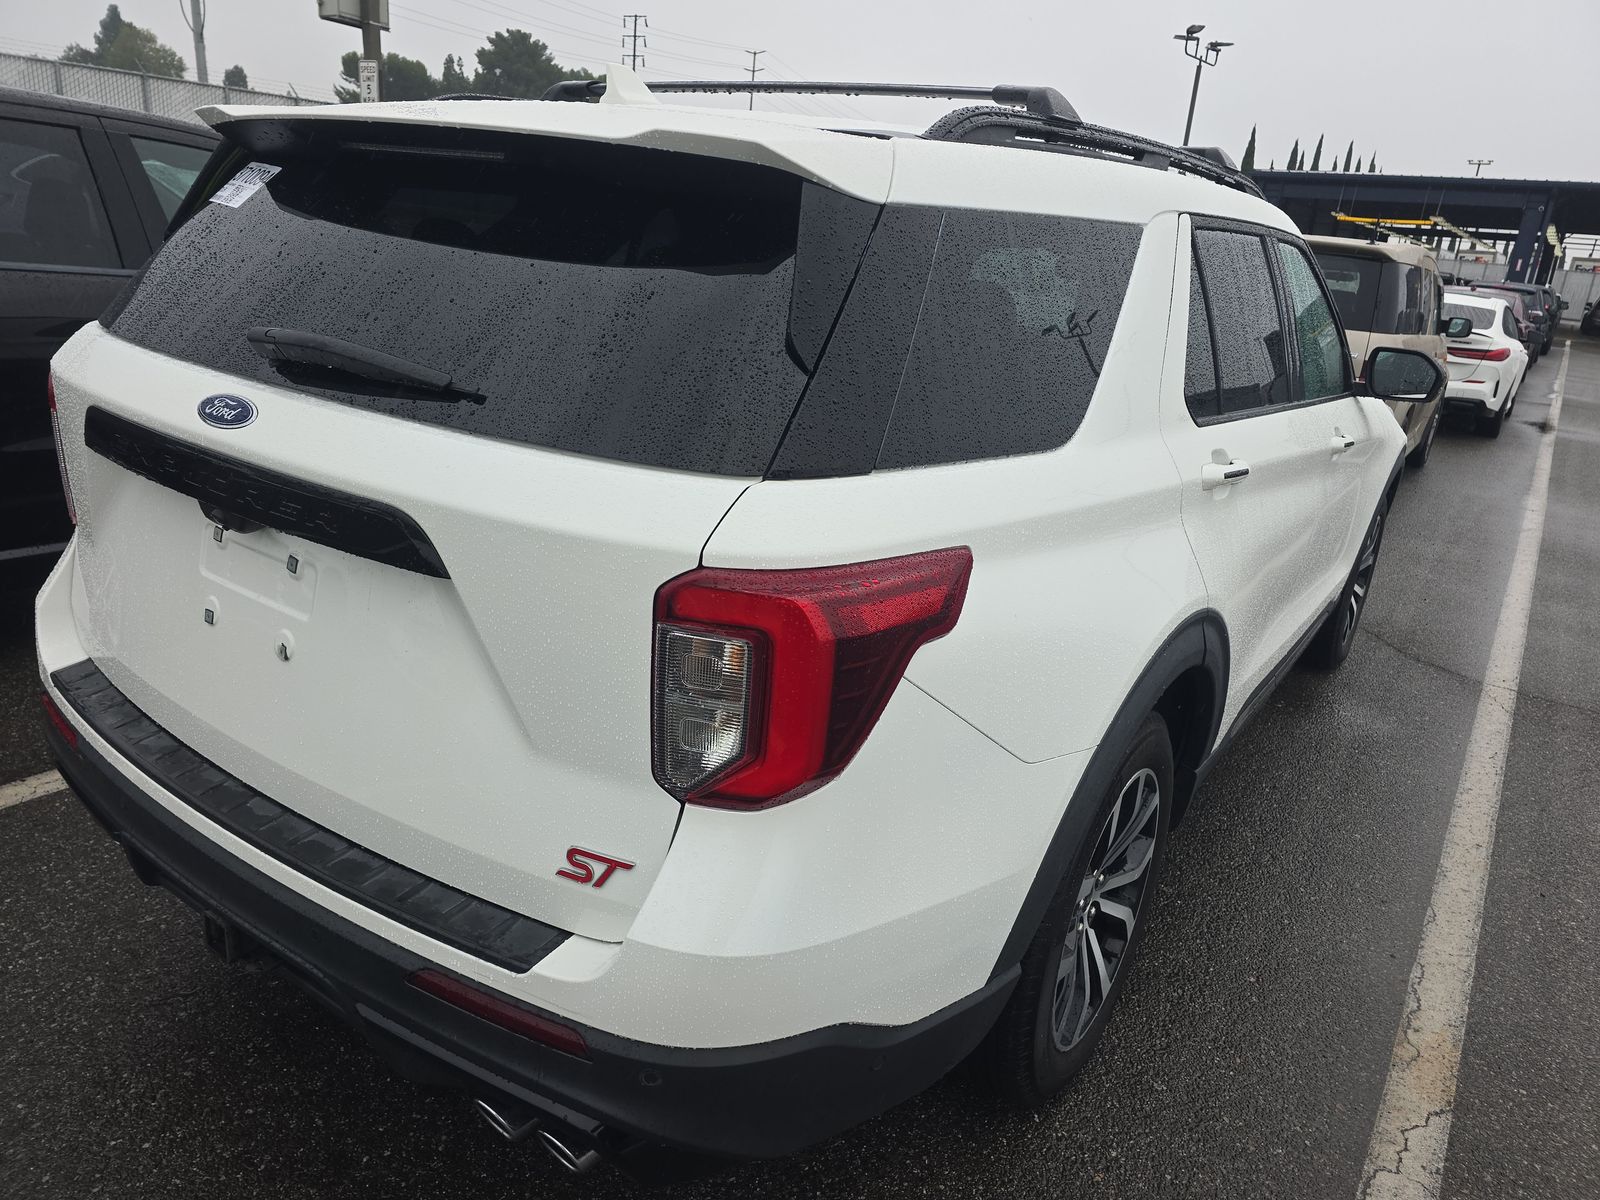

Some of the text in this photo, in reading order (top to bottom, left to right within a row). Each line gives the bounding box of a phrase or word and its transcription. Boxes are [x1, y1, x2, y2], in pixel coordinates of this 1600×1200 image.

[360, 65, 376, 74] SPEED
[366, 84, 372, 95] 5
[205, 397, 242, 420] Ford
[555, 845, 636, 888] ST
